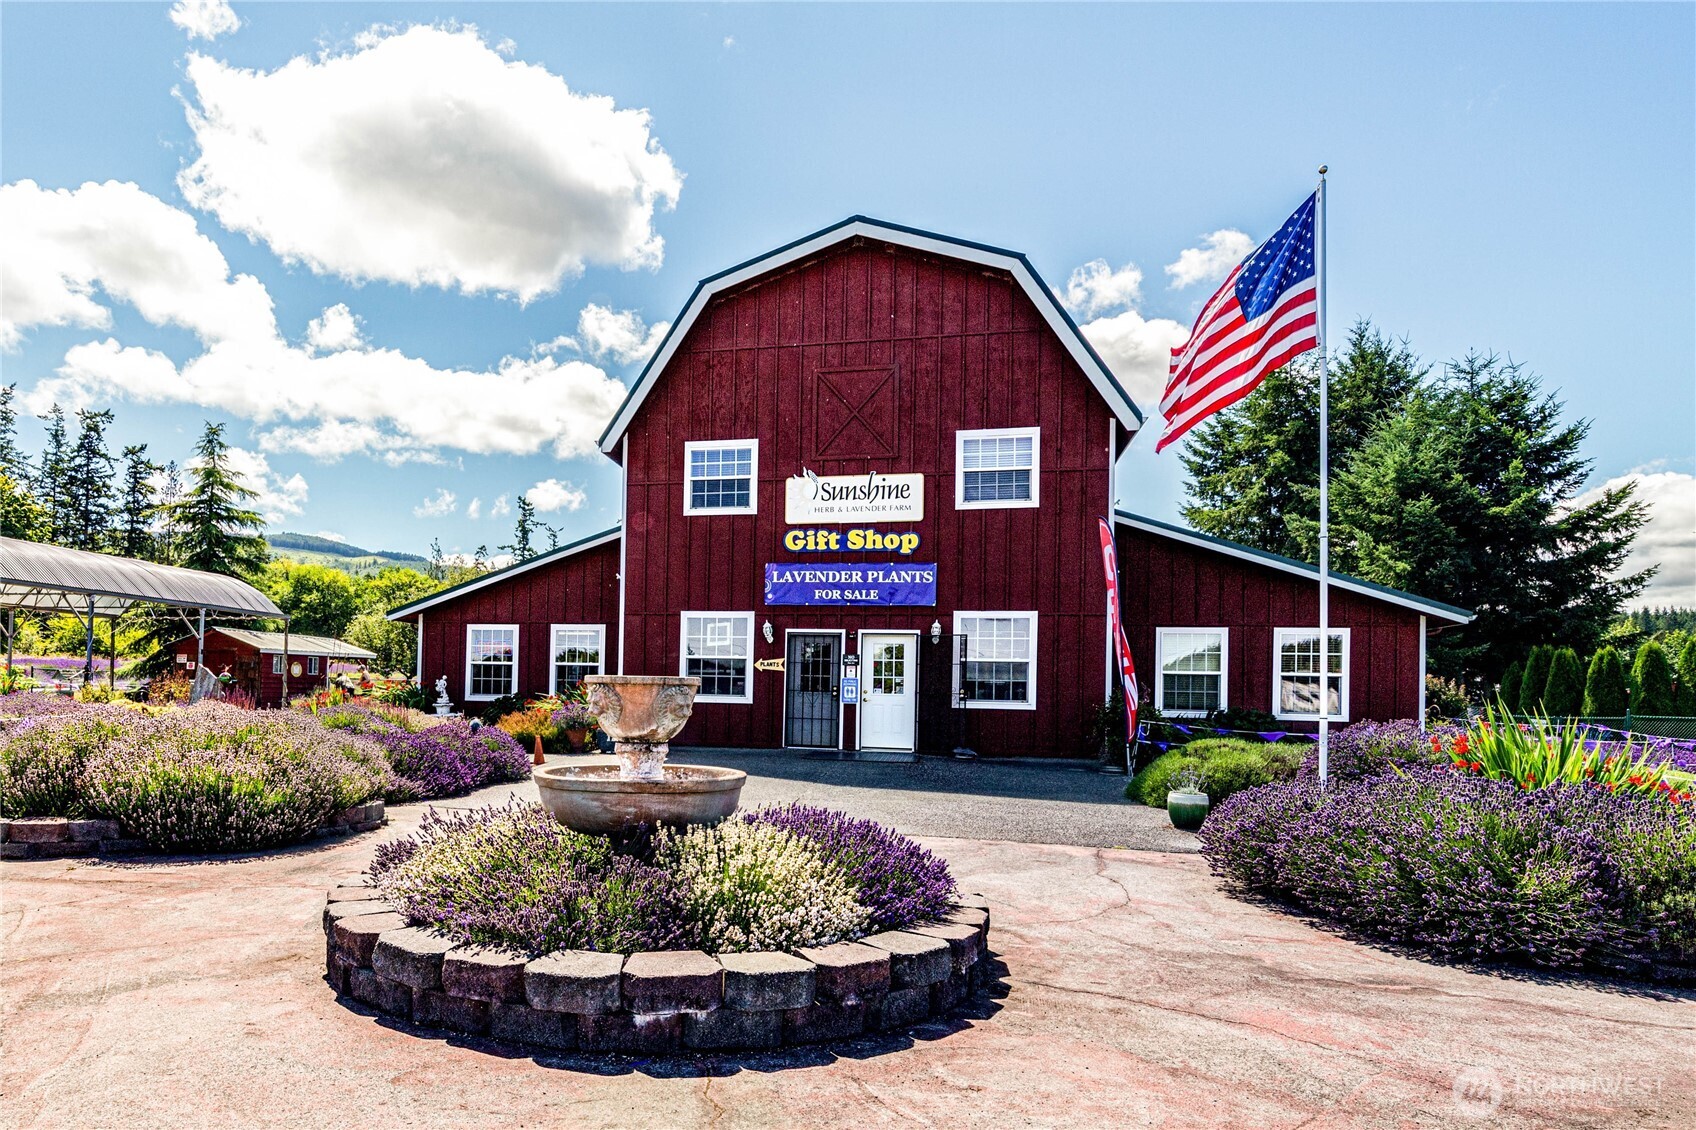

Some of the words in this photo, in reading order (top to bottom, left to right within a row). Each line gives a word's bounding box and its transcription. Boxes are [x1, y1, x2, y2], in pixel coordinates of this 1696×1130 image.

[821, 471, 911, 504] Sunshine
[785, 530, 840, 551] Gift
[847, 529, 919, 554] Shop
[772, 570, 863, 583] LAVENDER
[867, 570, 934, 583] PLANTS
[814, 589, 842, 600] FOR
[844, 589, 879, 600] SALE
